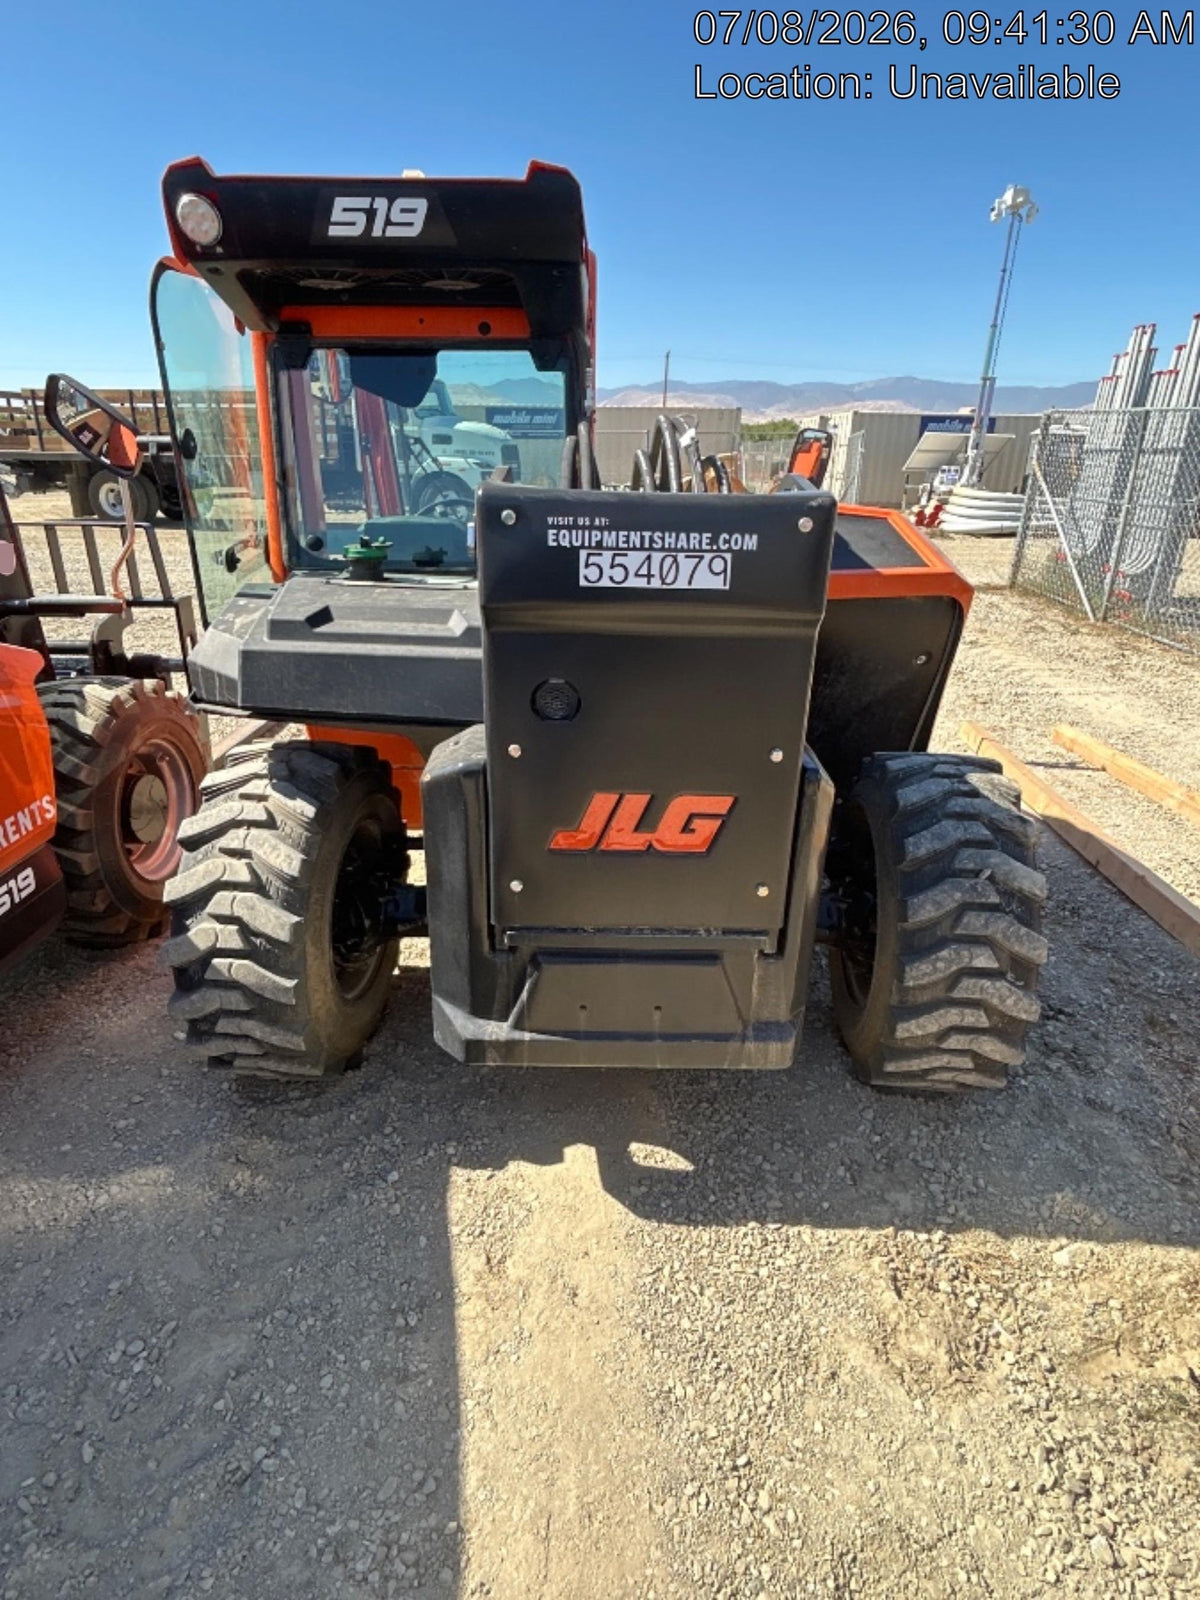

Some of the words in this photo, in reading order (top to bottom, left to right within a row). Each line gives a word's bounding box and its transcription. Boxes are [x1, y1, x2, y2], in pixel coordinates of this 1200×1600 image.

[327, 196, 429, 237] 519
[546, 529, 759, 551] EQUIPMENTSHARE.COM
[547, 516, 574, 526] VISIT
[577, 516, 591, 526] US
[594, 516, 609, 527] AT:
[581, 551, 729, 588] 554079
[548, 793, 738, 853] JLG
